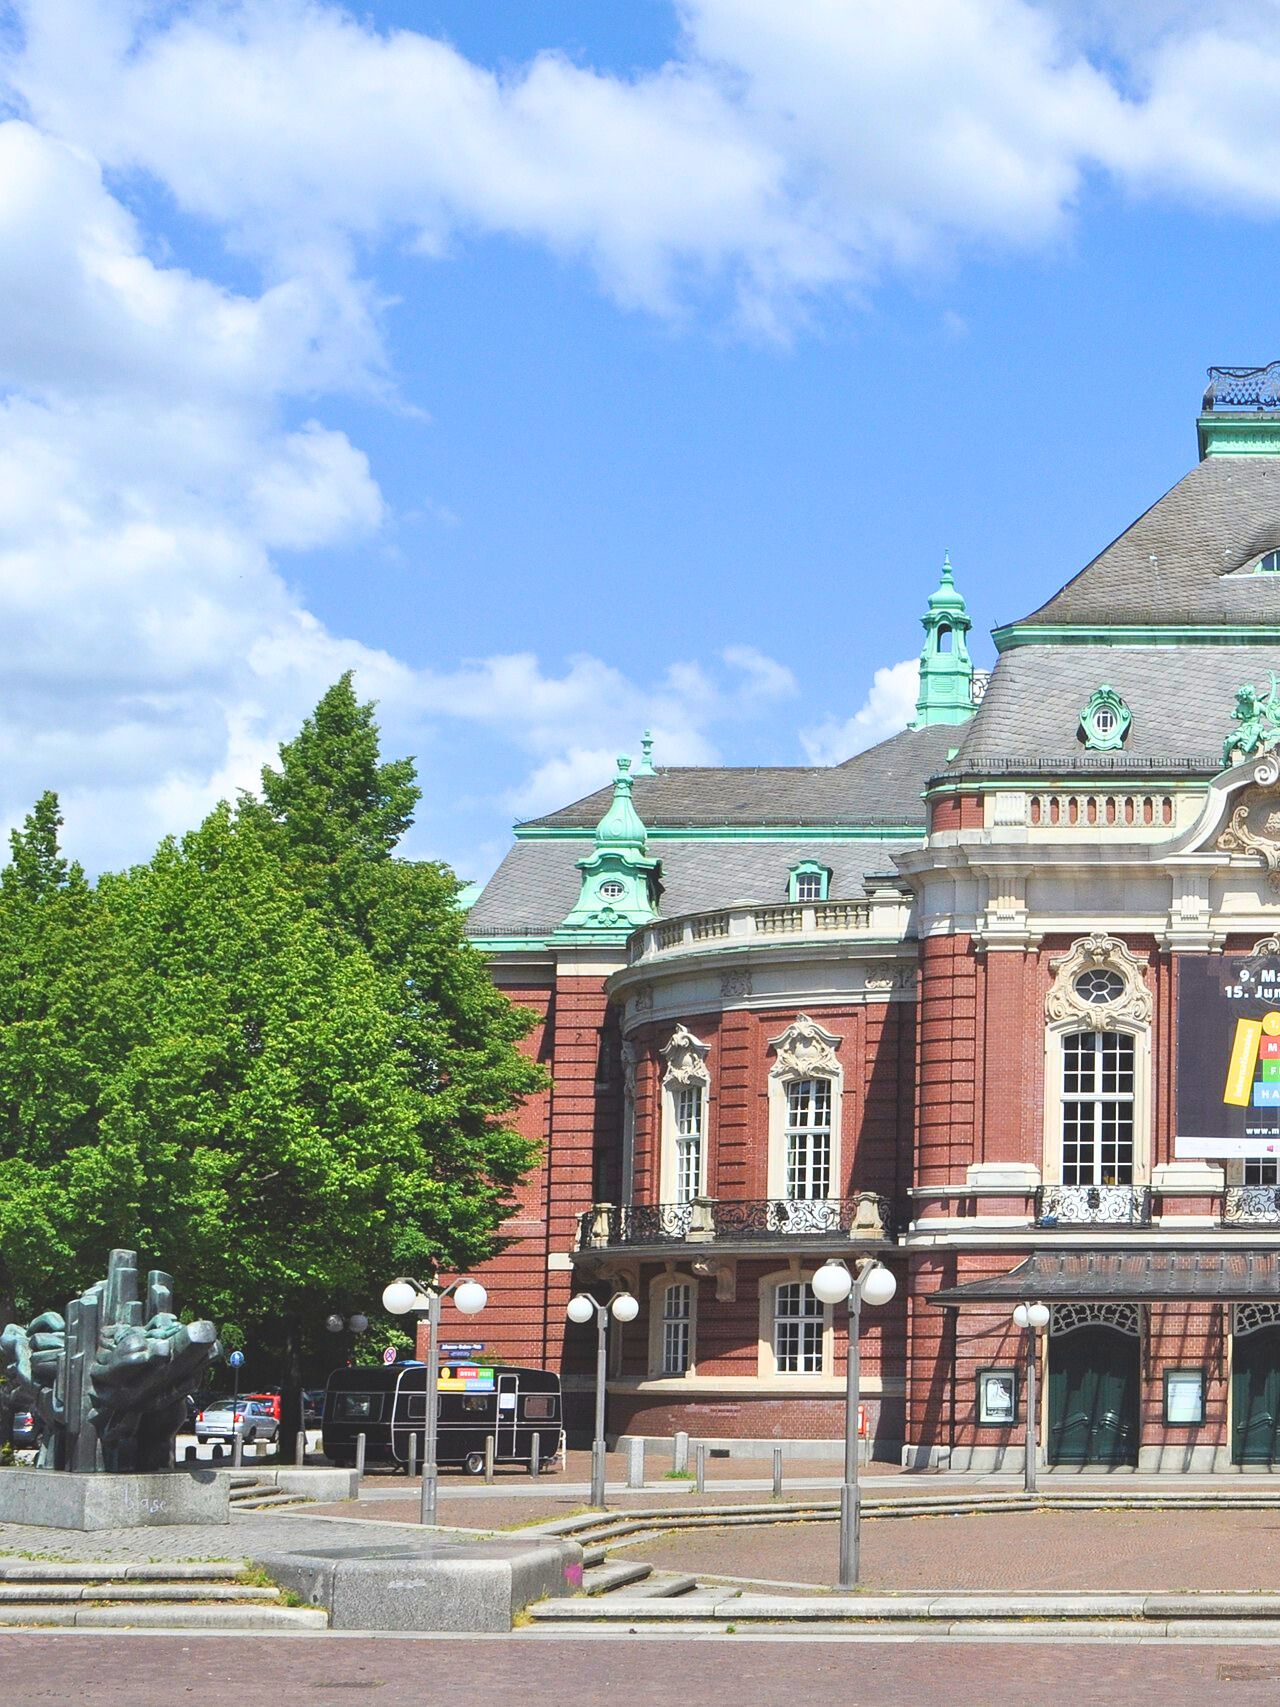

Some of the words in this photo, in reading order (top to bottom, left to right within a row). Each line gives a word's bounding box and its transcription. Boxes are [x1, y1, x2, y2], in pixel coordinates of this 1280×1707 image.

[1239, 969, 1255, 983] 9.
[1225, 985, 1249, 998] 15.
[1270, 1020, 1279, 1029] 1.
